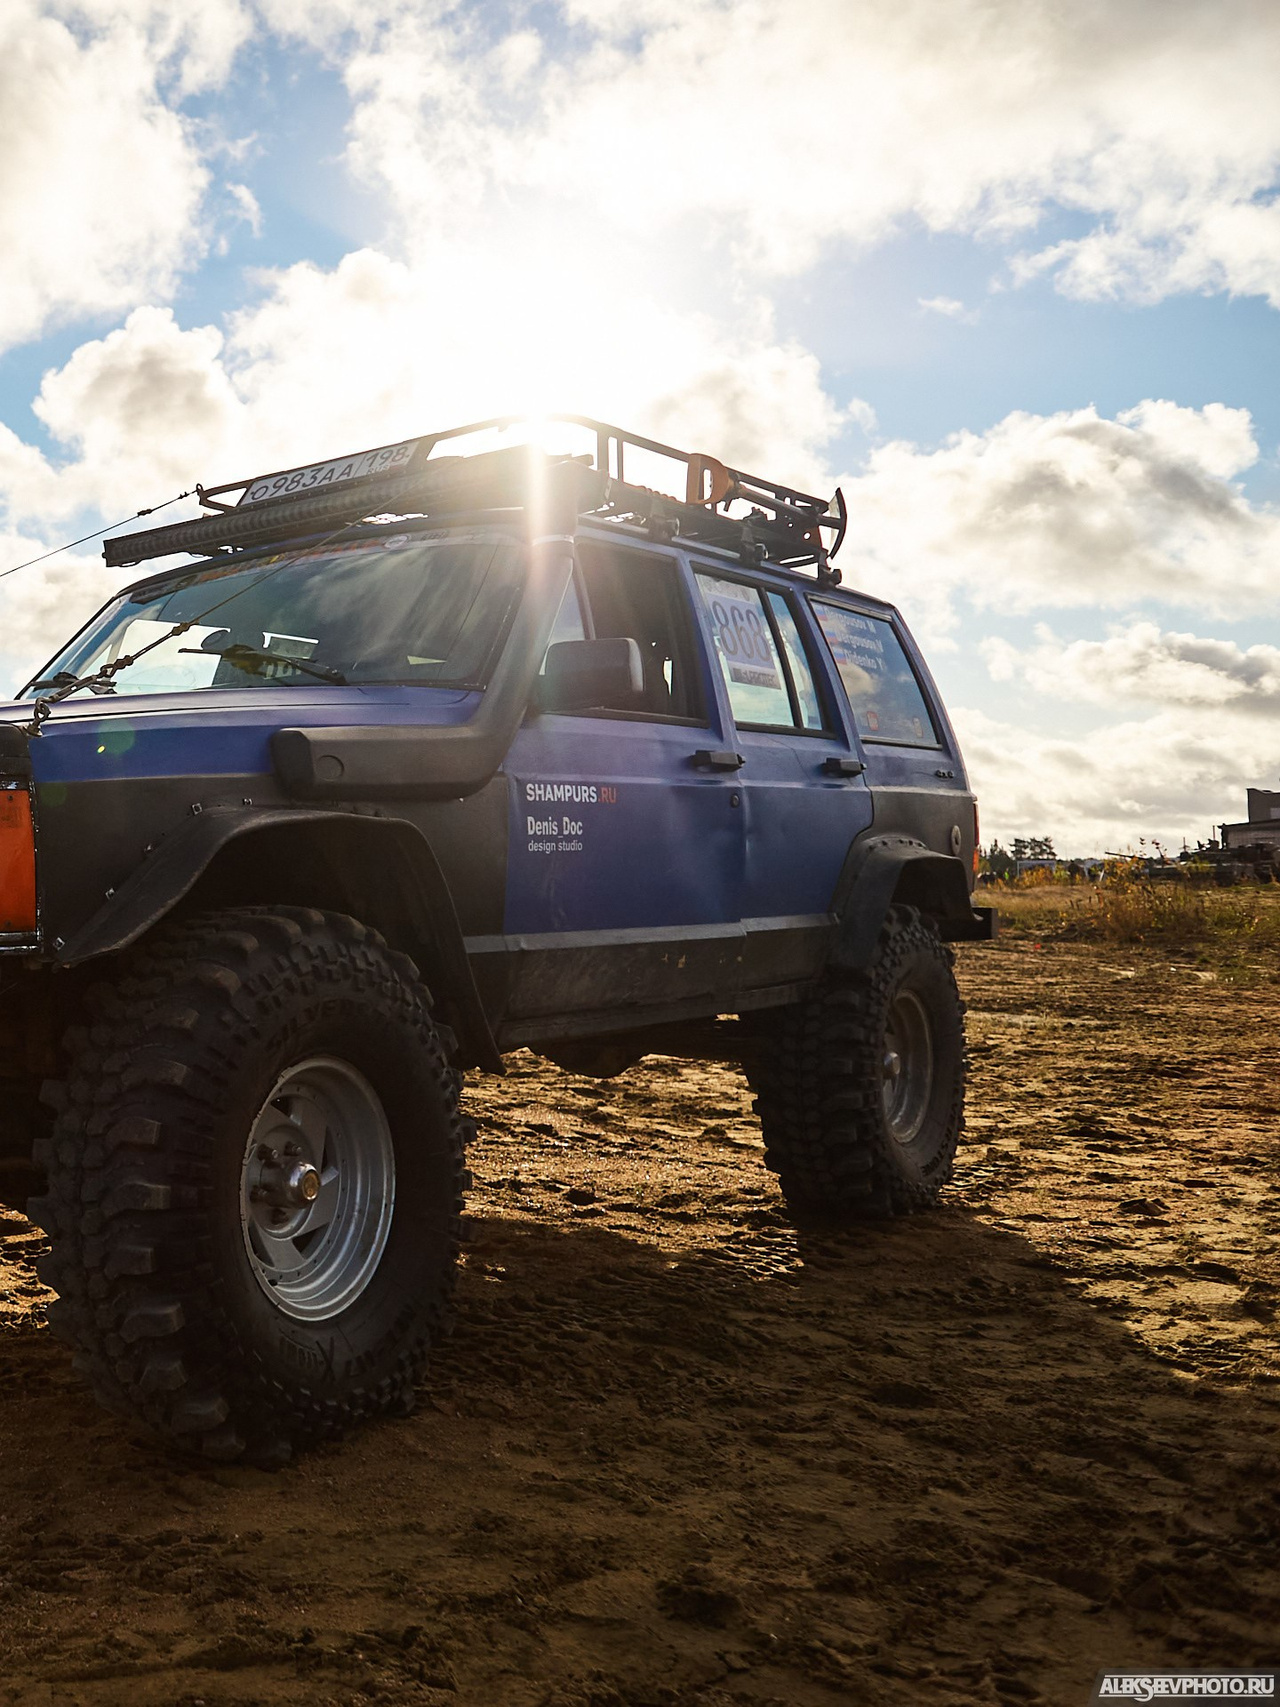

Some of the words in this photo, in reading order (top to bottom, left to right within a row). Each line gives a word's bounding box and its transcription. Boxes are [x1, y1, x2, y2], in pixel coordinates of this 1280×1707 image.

[712, 600, 771, 661] 868
[526, 783, 616, 803] SHAMPURS.RU
[528, 840, 556, 854] design
[557, 840, 583, 852] studio
